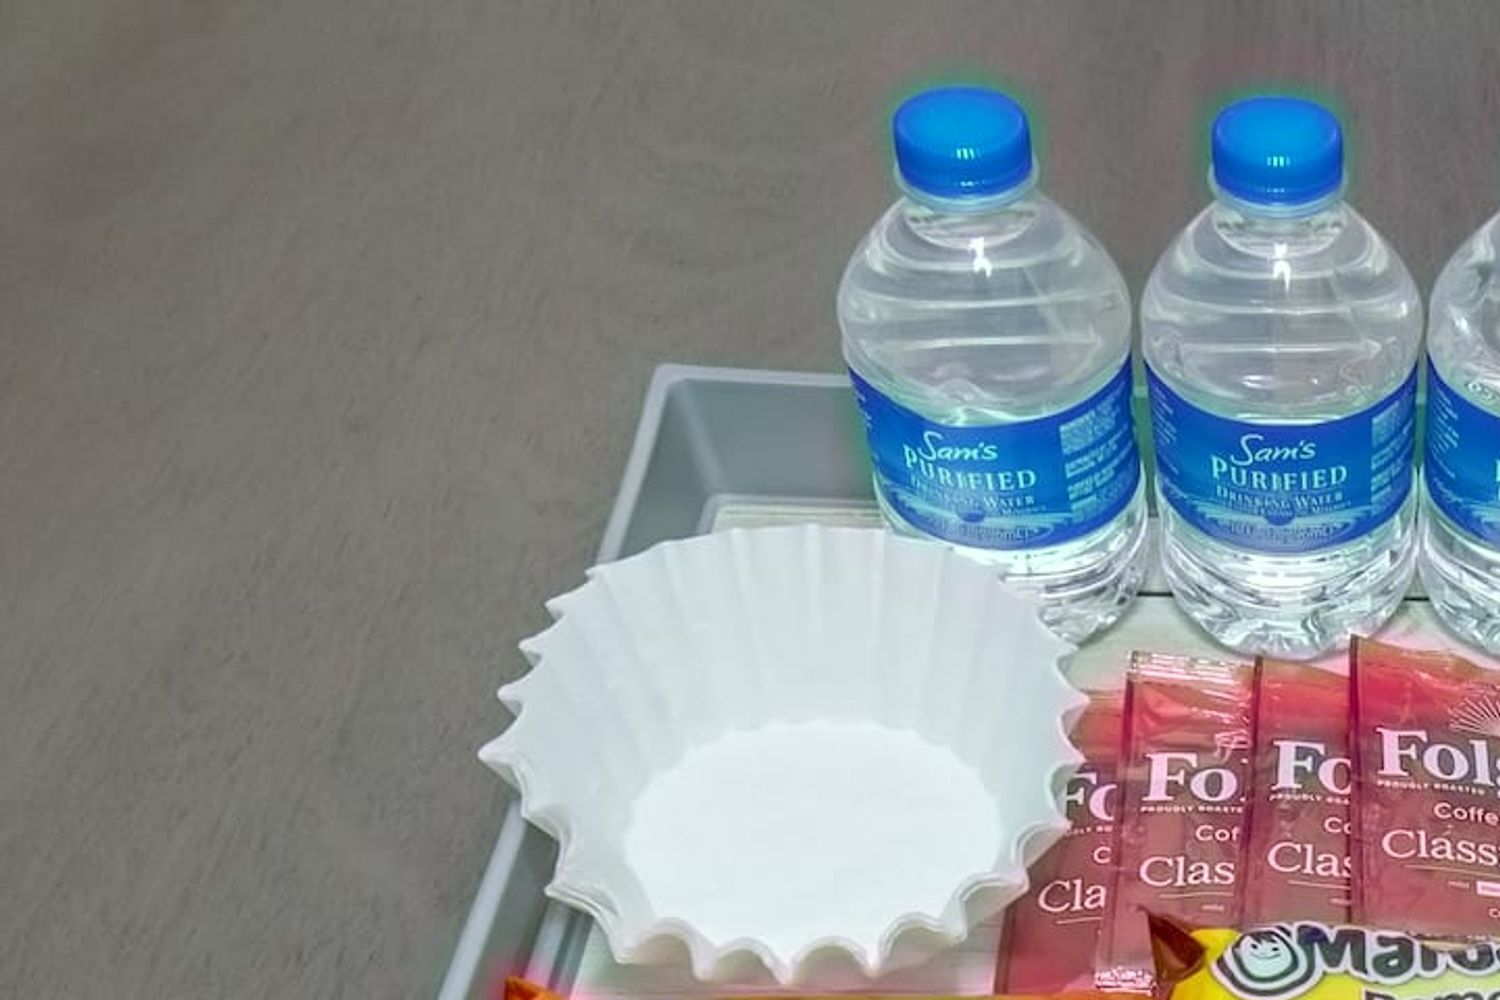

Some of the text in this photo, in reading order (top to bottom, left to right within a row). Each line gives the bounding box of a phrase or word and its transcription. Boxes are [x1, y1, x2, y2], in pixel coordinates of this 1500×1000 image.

[917, 431, 999, 461] Sam's
[1229, 433, 1317, 466] Sam's
[902, 443, 1037, 491] PURIFIED
[1211, 453, 1348, 491] PURIFIED
[1141, 752, 1247, 803] Fo
[1195, 824, 1240, 841] Cof
[1139, 856, 1236, 887] Clas
[1038, 878, 1107, 912] Cla
